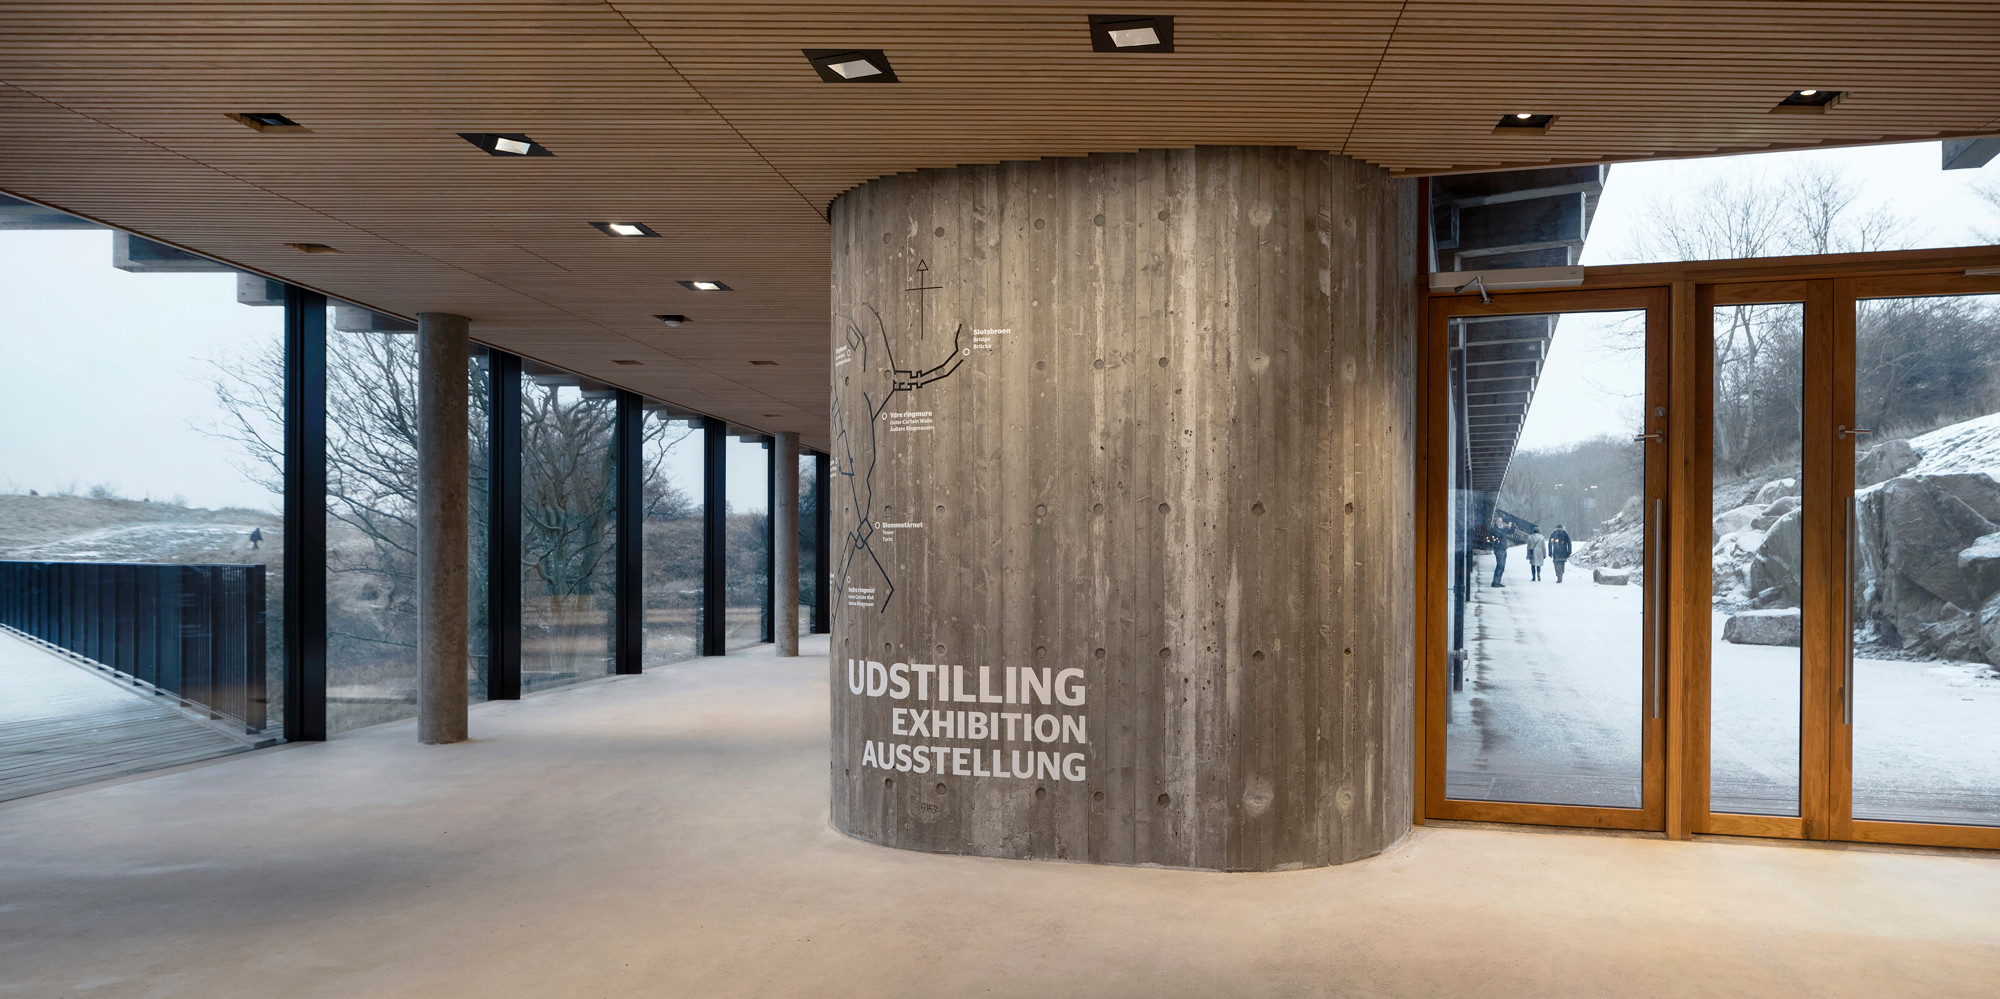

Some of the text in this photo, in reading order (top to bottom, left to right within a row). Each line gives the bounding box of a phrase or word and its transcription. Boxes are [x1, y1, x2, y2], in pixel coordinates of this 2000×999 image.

[973, 328, 1011, 336] Slotsbroen
[904, 411, 933, 419] ringmure
[848, 658, 1086, 706] UDSTILLING
[892, 707, 1086, 744] EXHIBITION
[862, 740, 1086, 782] AUSSTELLUNG
